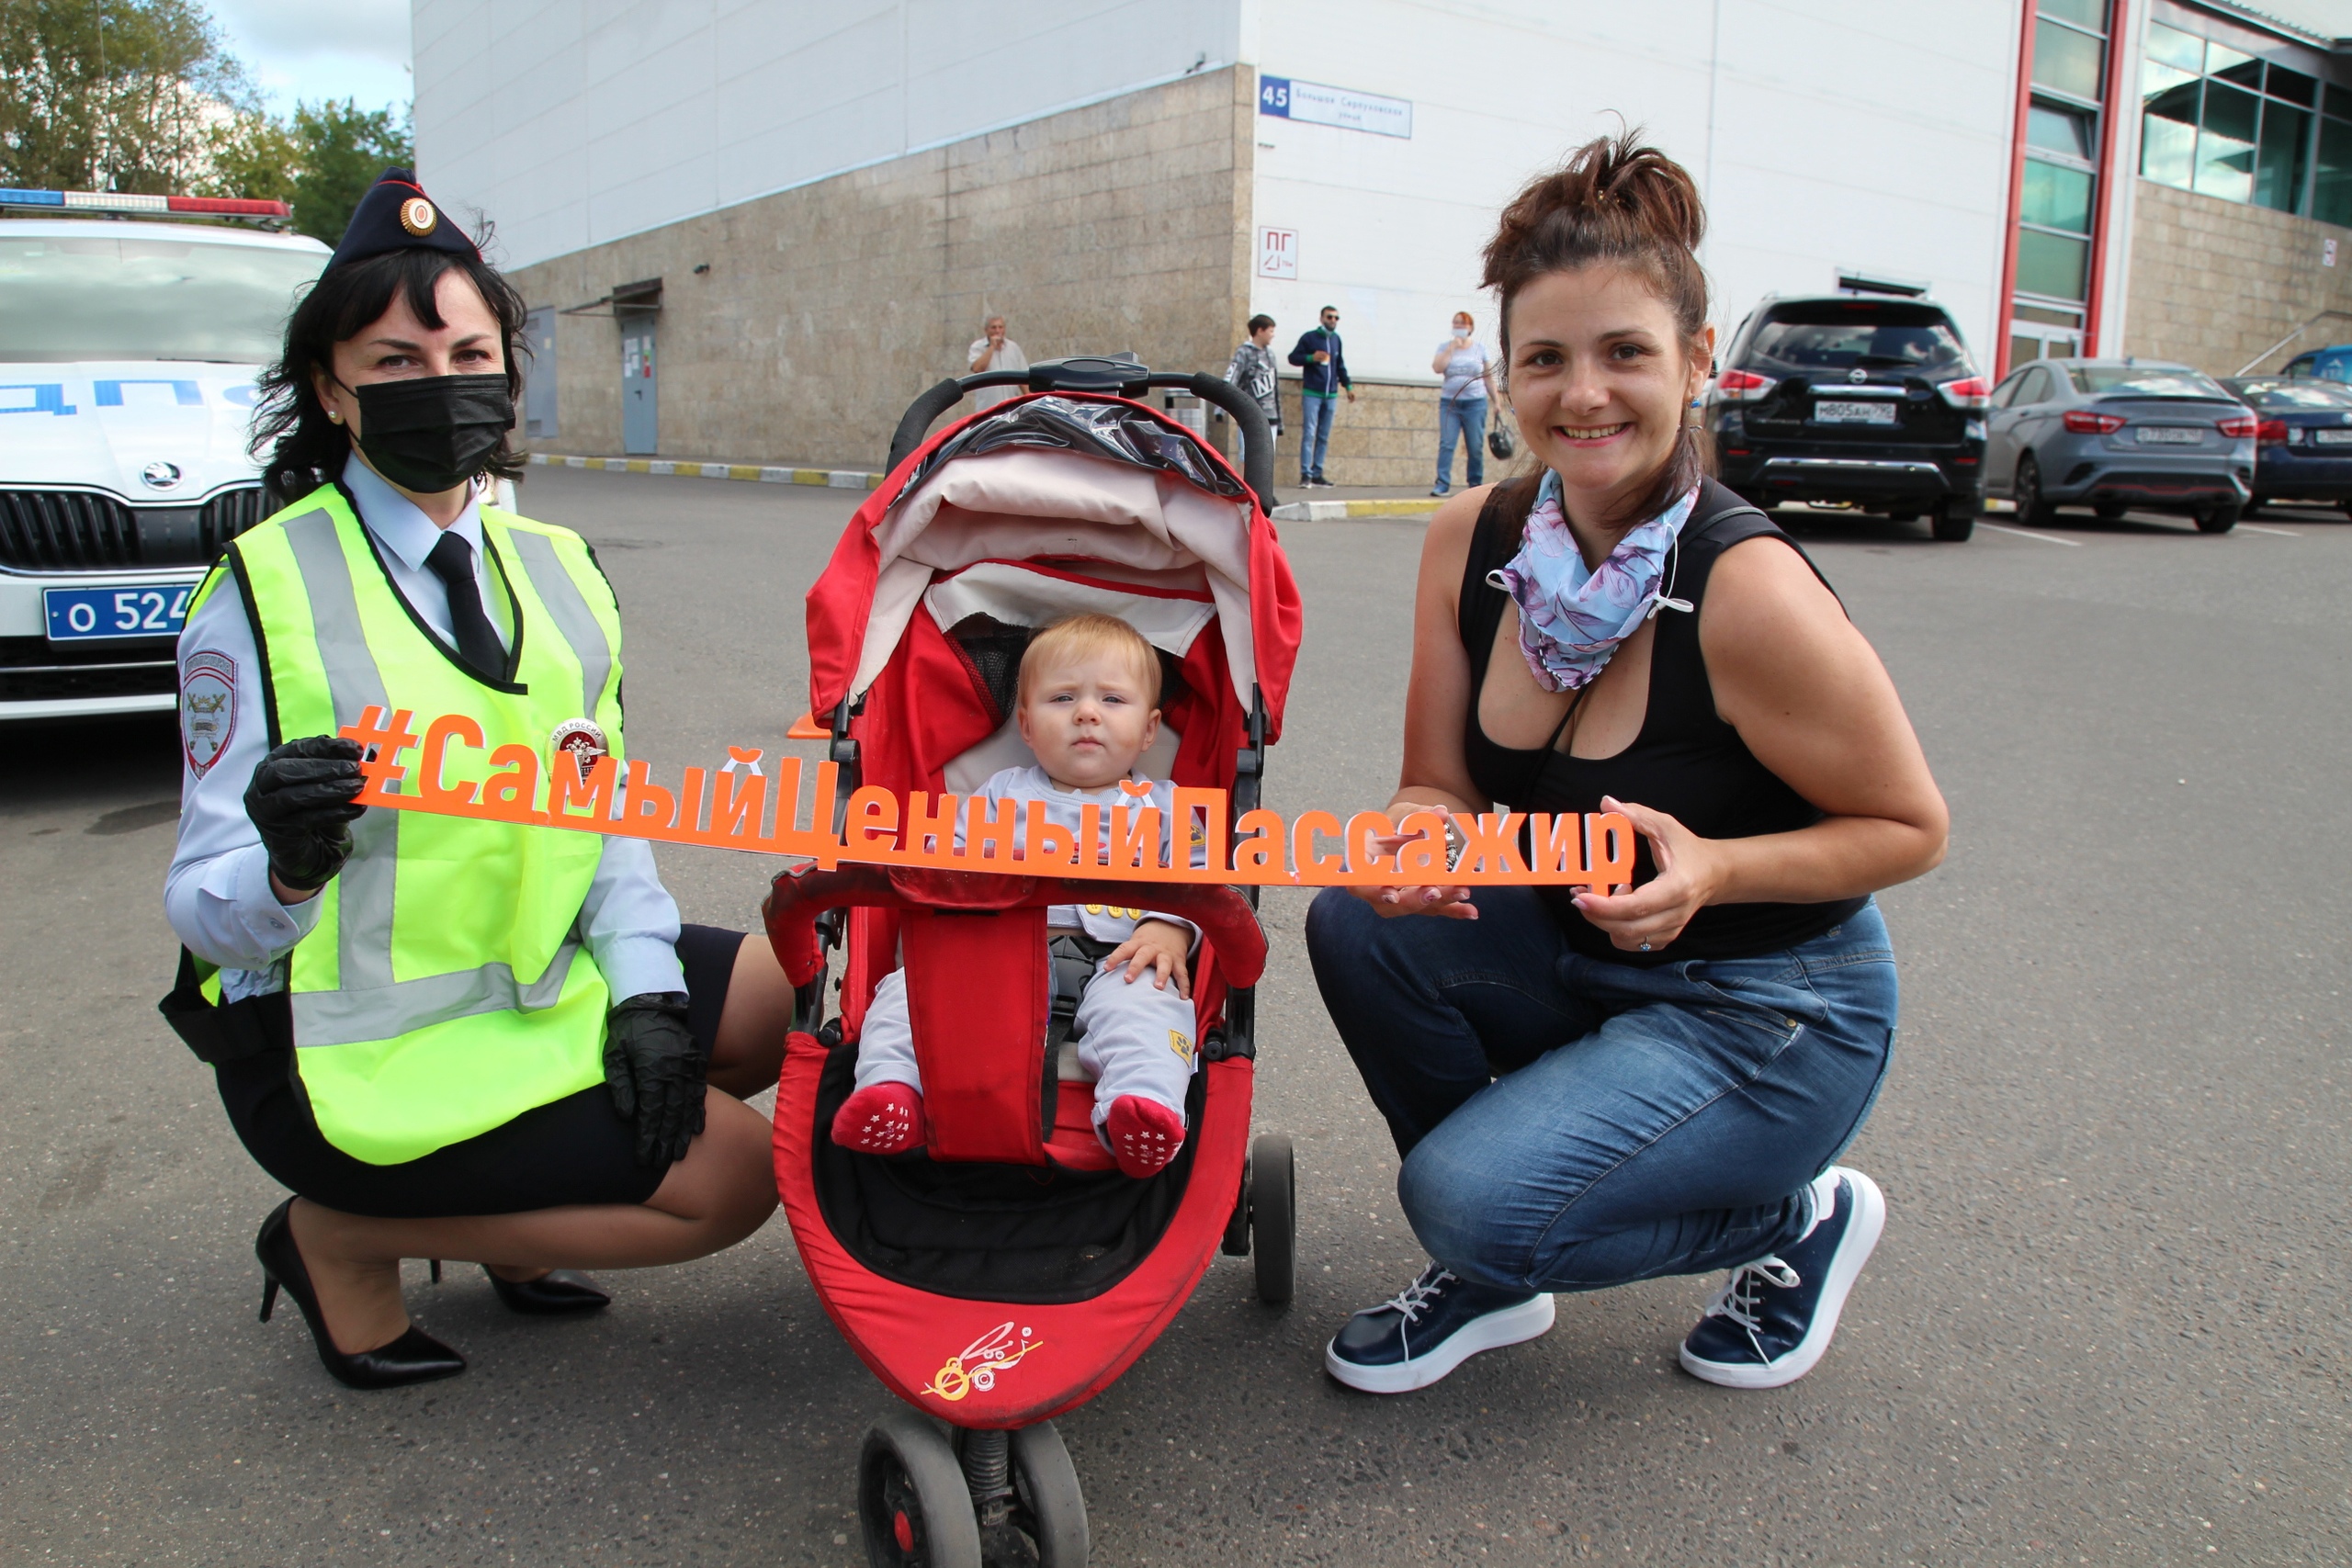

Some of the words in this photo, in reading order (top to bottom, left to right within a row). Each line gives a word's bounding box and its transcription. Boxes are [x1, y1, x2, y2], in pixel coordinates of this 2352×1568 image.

[1261, 85, 1287, 107] 45
[1267, 231, 1292, 252] ПГ
[552, 726, 569, 742] МВД
[569, 722, 602, 739] РОССИИ
[338, 704, 1636, 897] #СамыйЦенныйПассажир
